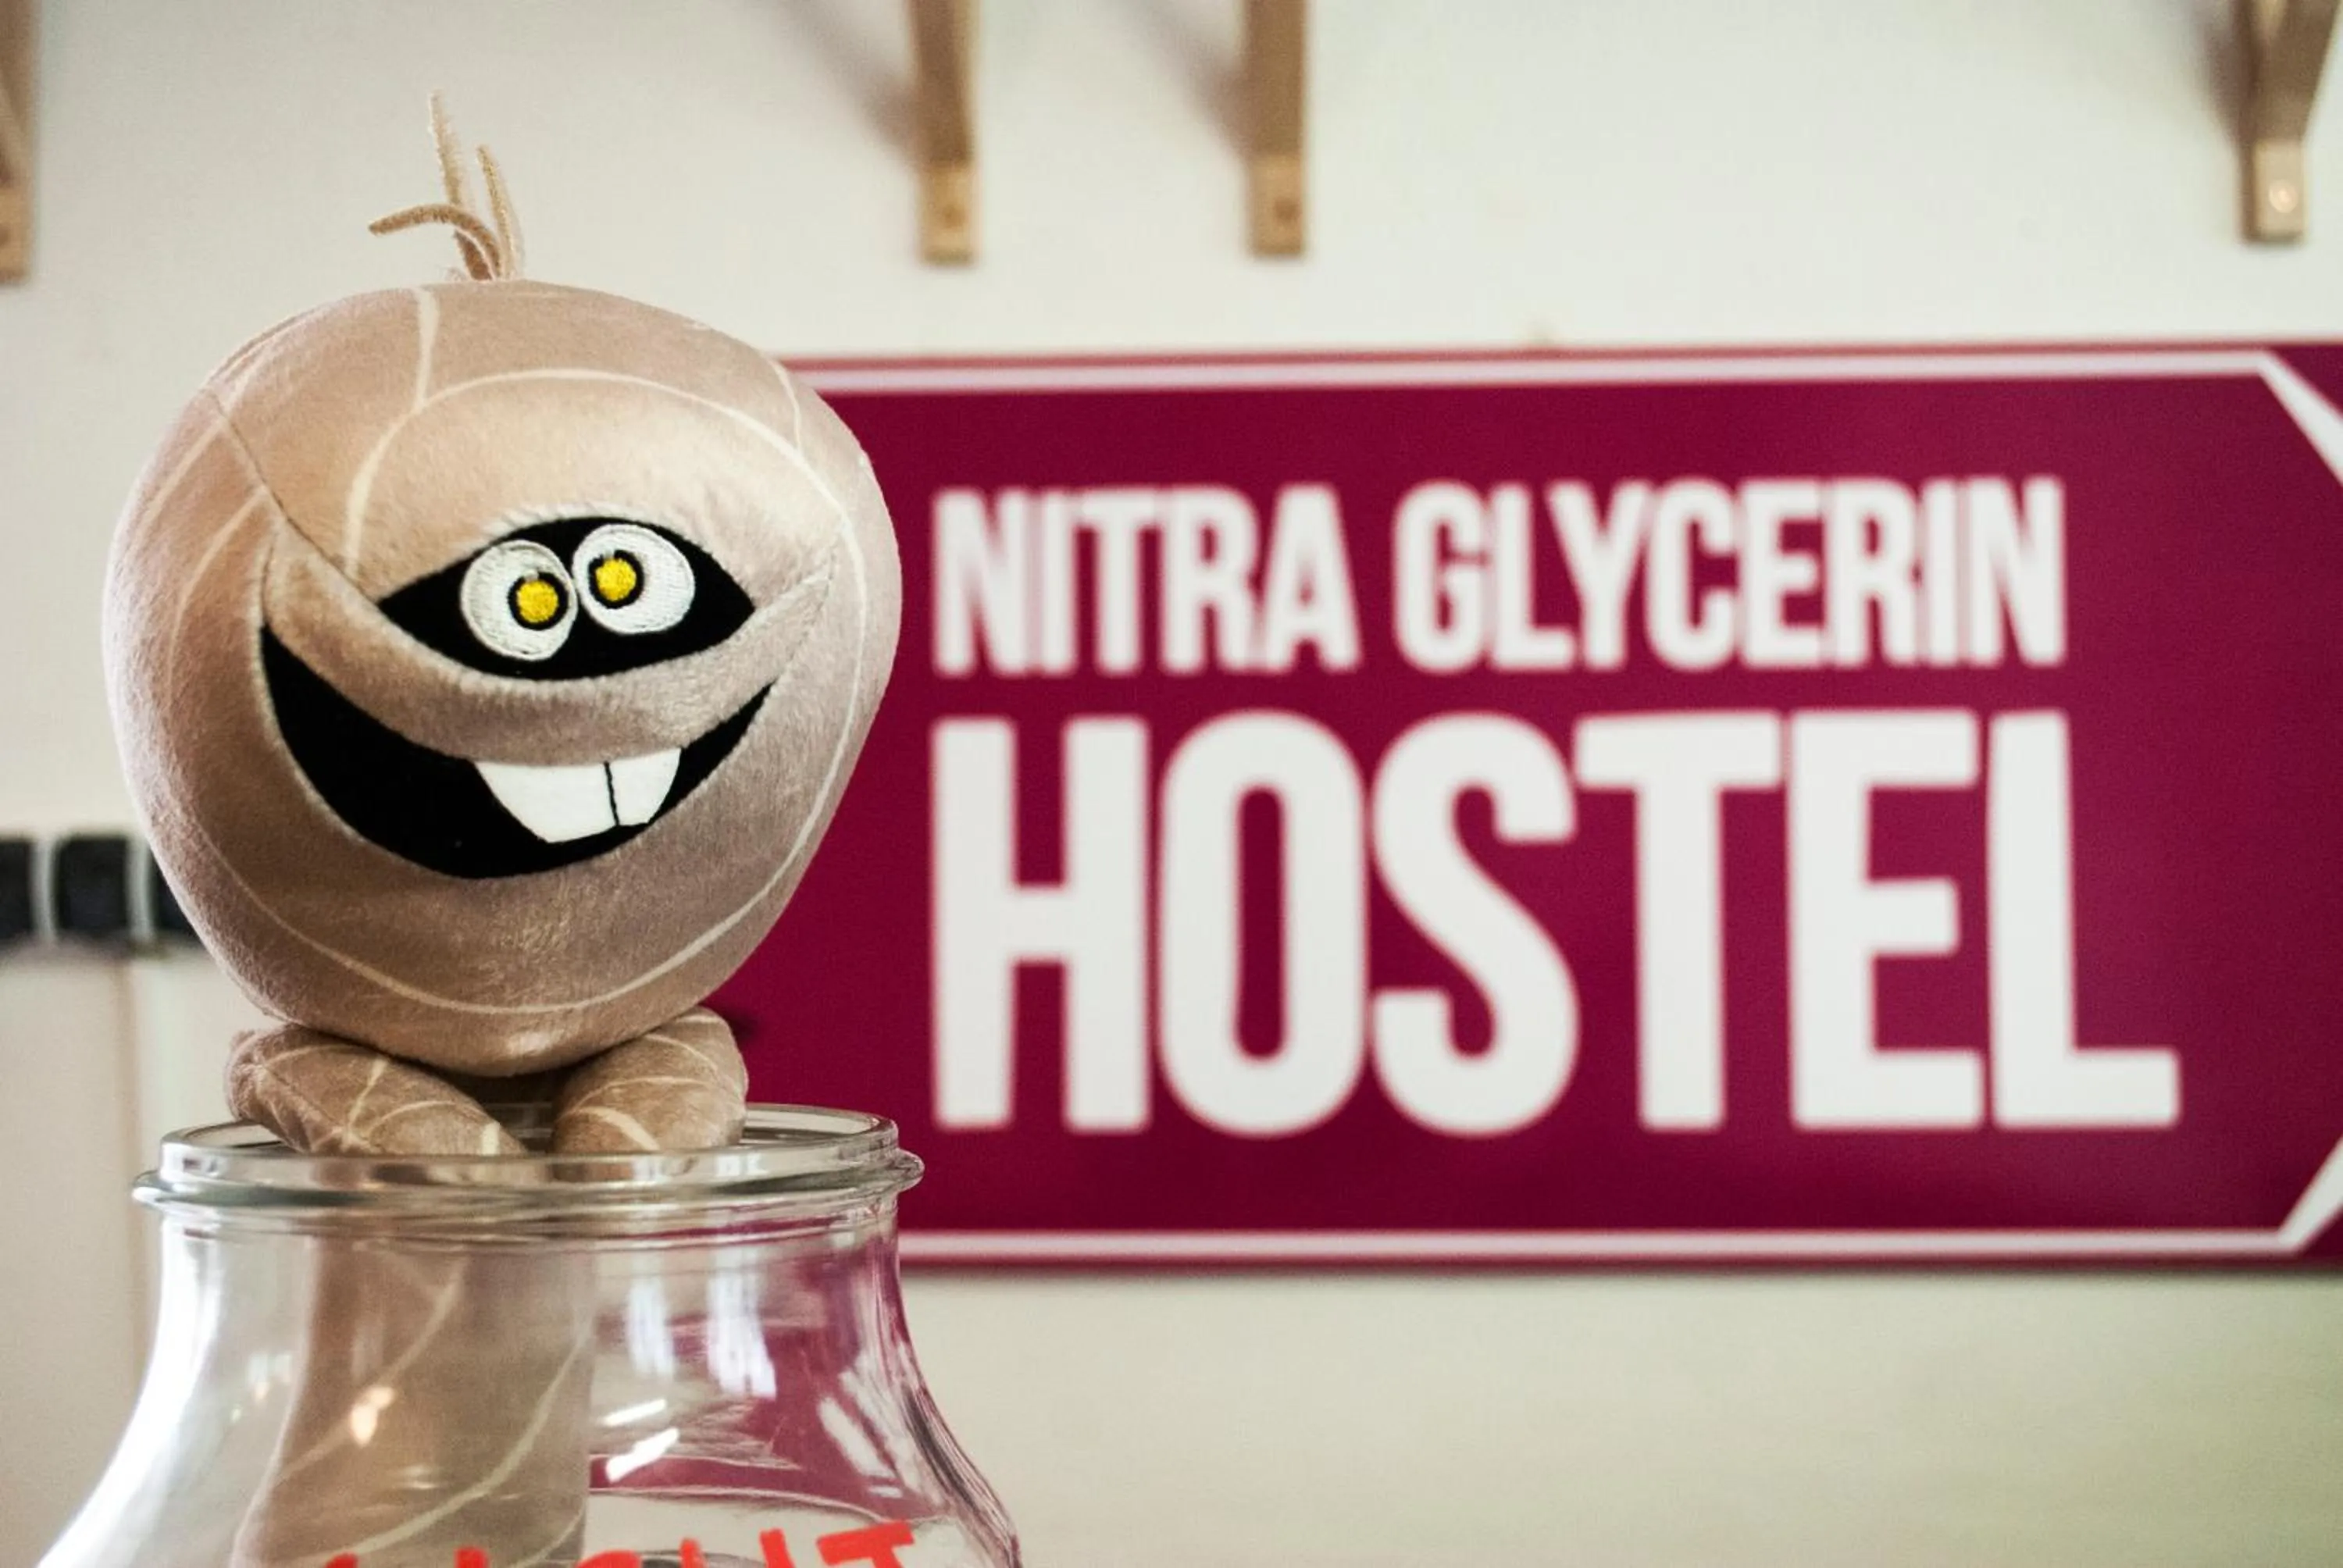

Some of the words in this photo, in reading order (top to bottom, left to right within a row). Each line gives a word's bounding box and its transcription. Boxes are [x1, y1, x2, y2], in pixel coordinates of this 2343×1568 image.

[933, 484, 1360, 675] NITRA
[1394, 478, 2065, 671] GLYCERIN
[932, 709, 2181, 1137] HOSTEL
